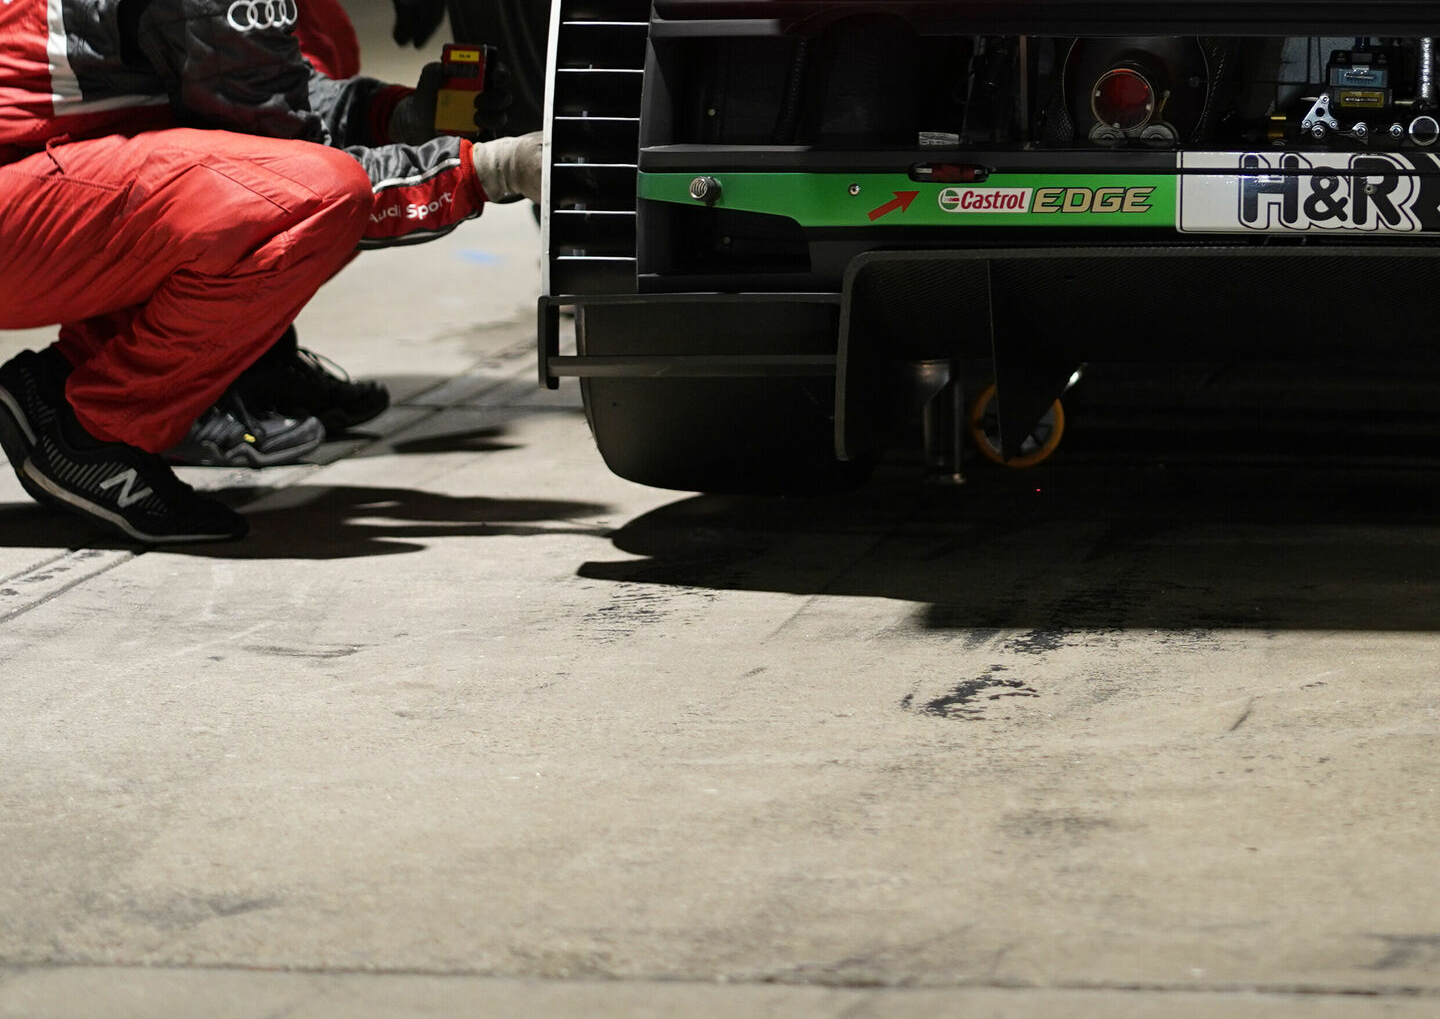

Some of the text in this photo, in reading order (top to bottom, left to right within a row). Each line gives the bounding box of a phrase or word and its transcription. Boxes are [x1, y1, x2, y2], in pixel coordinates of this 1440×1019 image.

[406, 191, 453, 220] Sport
[960, 186, 1157, 213] Castrol EDGE
[1239, 153, 1423, 230] H&R
